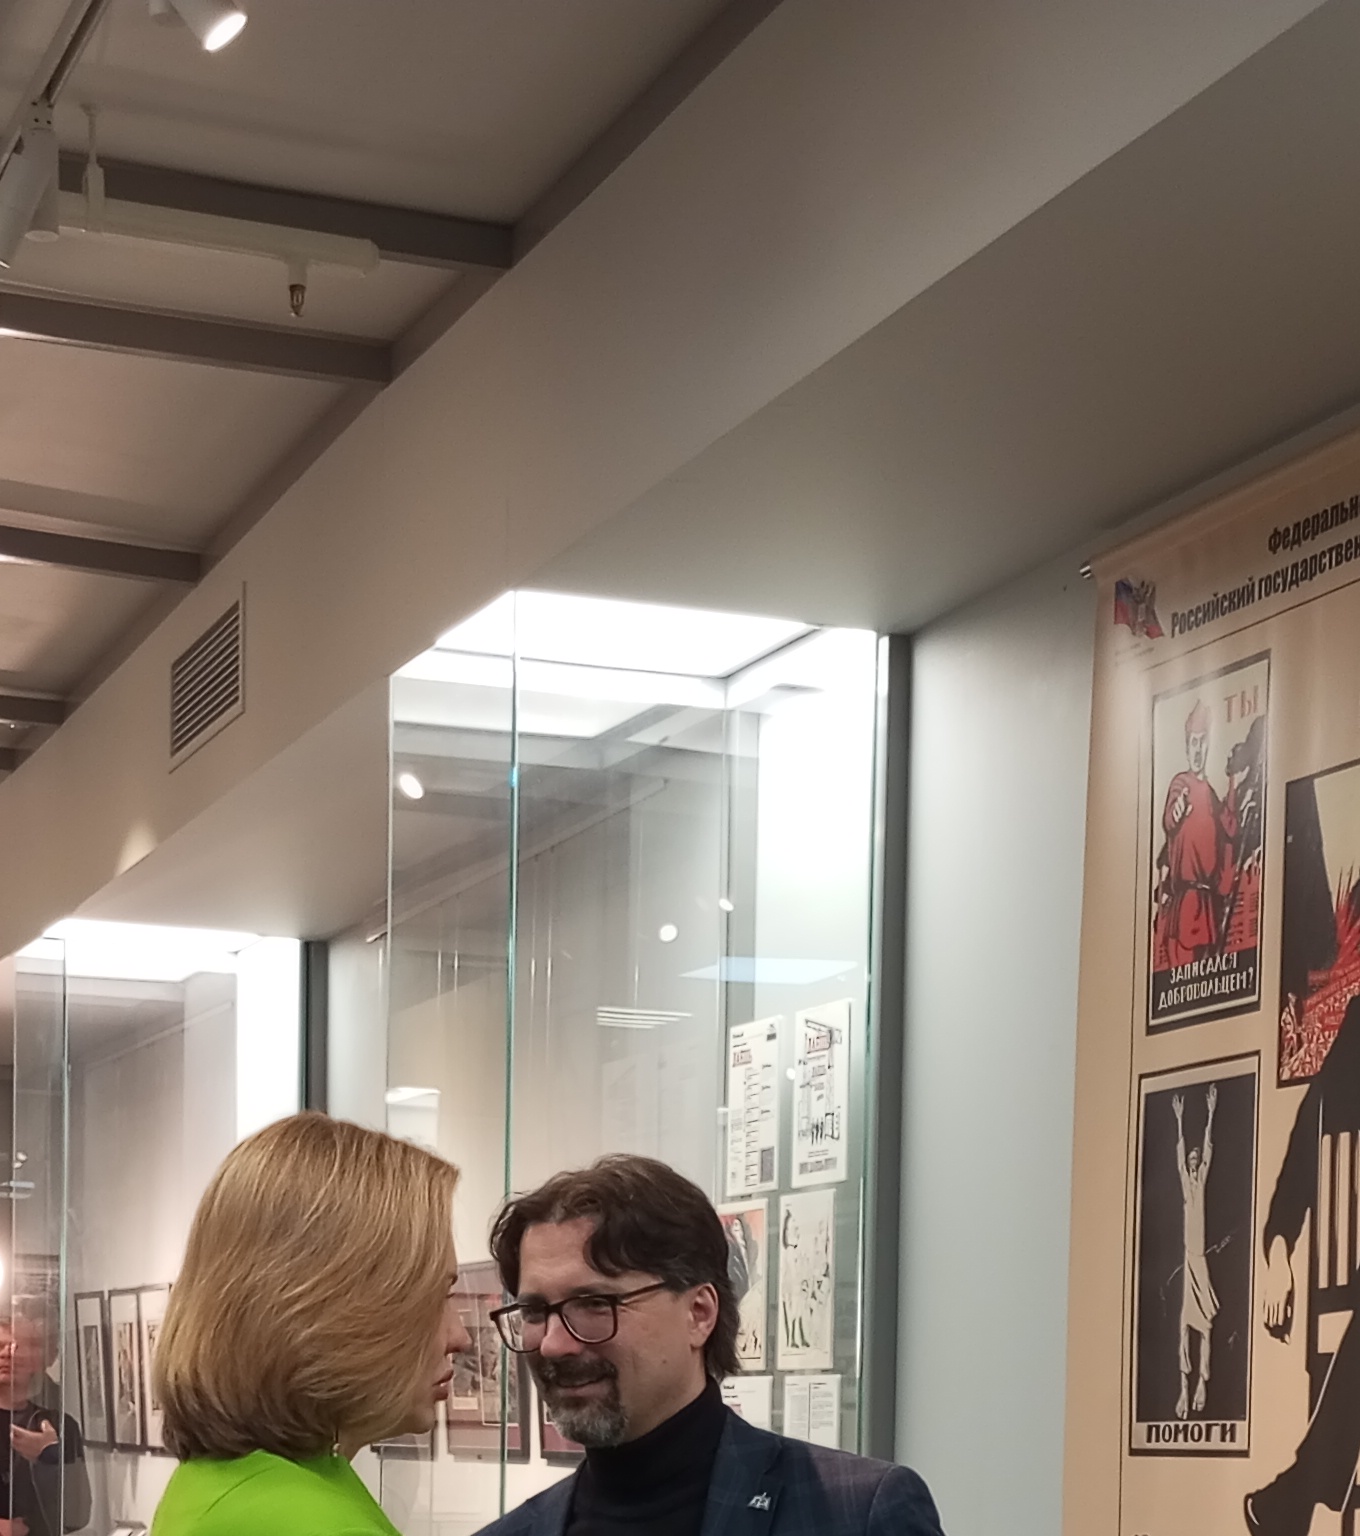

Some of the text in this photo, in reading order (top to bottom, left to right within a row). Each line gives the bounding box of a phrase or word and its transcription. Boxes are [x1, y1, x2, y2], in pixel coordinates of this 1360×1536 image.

[1171, 576, 1255, 639] Российский
[1223, 685, 1259, 724] ТЫ
[1169, 952, 1238, 984] ЗАПИСАЛСЯ
[1145, 1421, 1237, 1445] ПОМОГИ
